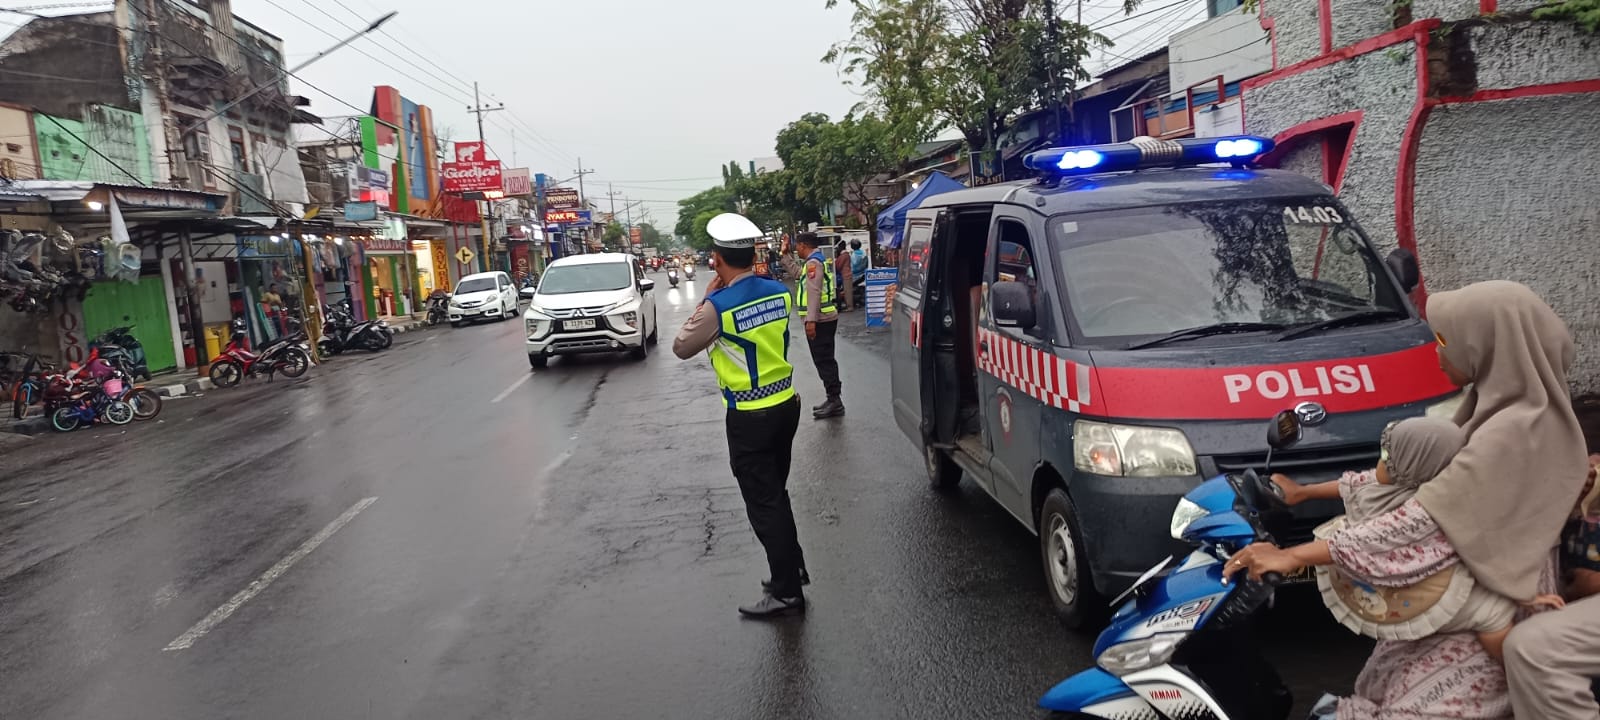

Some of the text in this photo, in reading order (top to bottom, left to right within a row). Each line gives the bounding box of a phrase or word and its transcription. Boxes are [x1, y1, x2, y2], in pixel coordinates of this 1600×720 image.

[1283, 206, 1343, 223] 14.03
[1223, 364, 1376, 403] POLISI
[1149, 689, 1182, 700] YAMAHA
